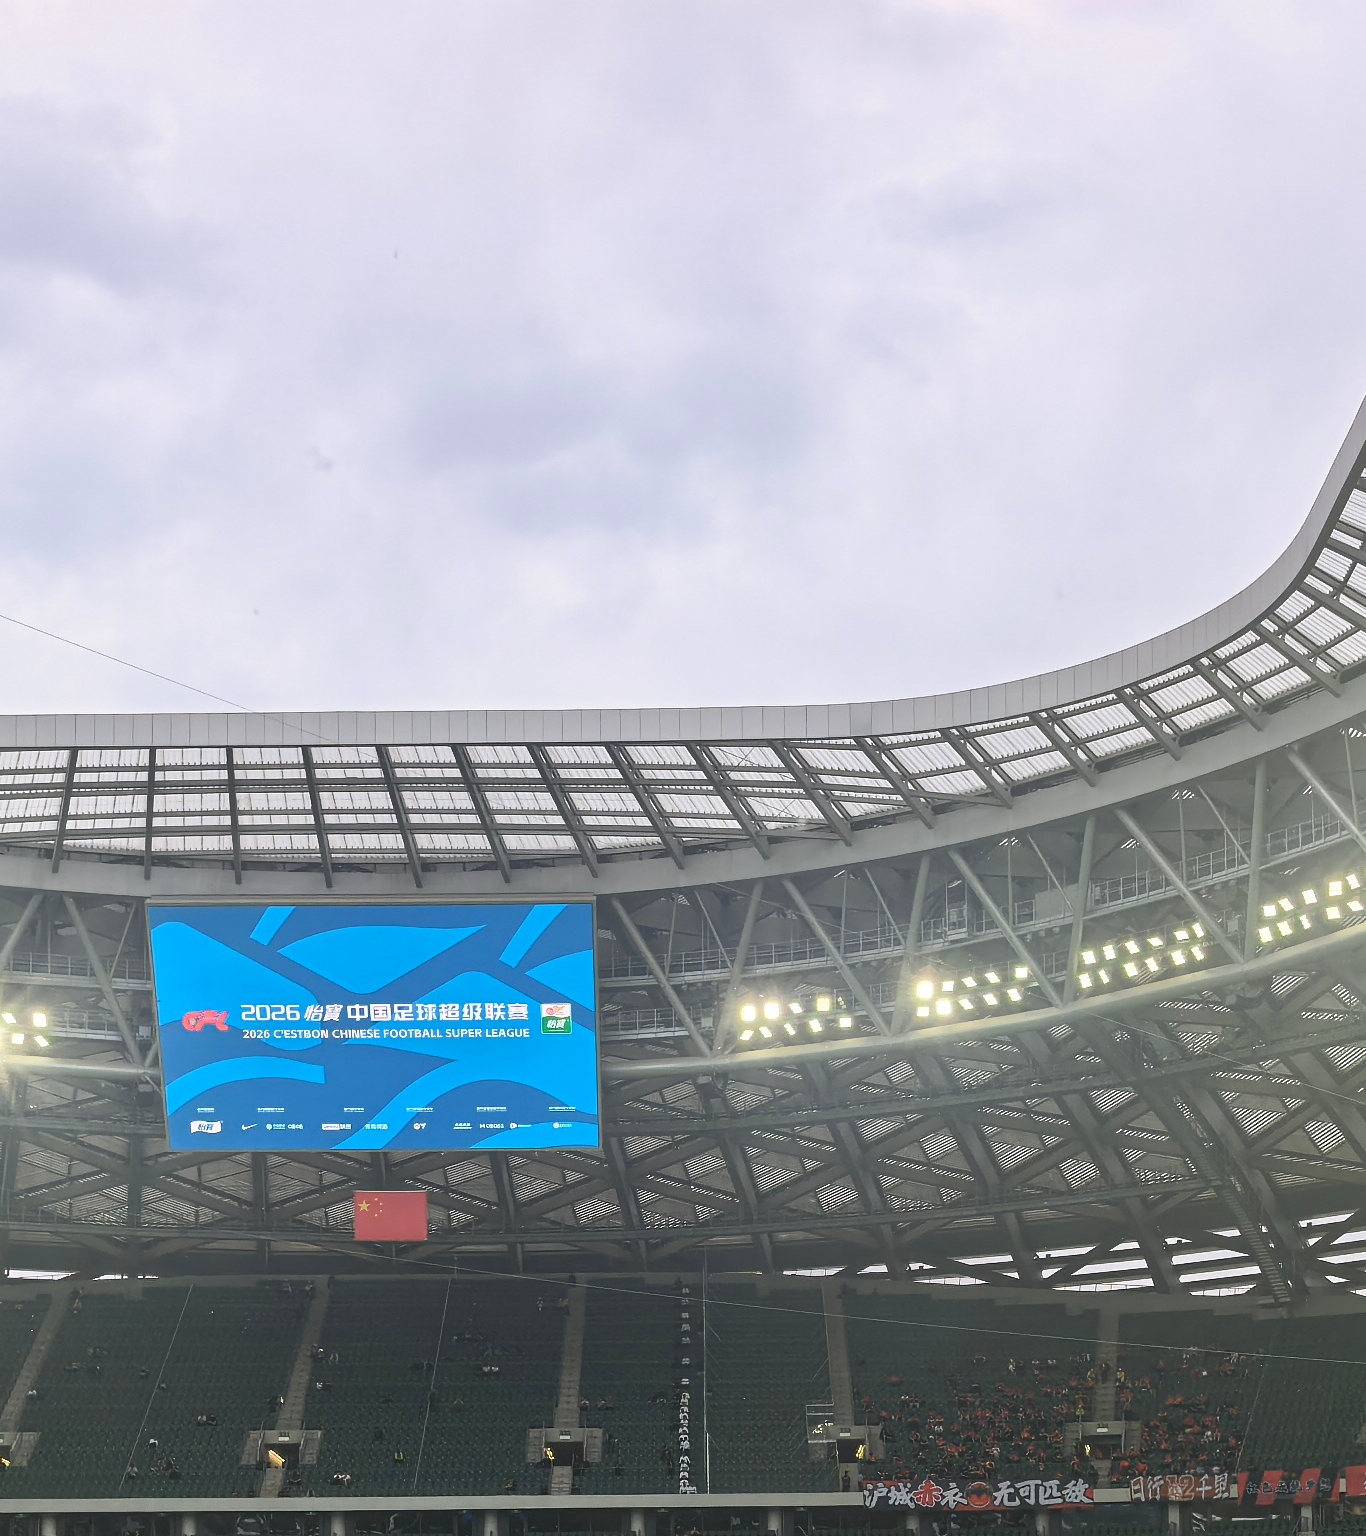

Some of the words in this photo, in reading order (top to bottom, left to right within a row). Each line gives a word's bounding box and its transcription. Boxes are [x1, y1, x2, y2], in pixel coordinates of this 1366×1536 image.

[241, 1003, 300, 1021] 2026
[304, 1003, 342, 1021] 怡寶
[347, 1002, 529, 1022] 中国足球超级联赛
[242, 1029, 270, 1040] 2026
[273, 1028, 329, 1040] C'ESTBON
[332, 1028, 380, 1039] CHINESE
[383, 1028, 442, 1039] FOOTBALL
[445, 1028, 480, 1039] SUPER
[483, 1027, 530, 1039] LEAGUE
[864, 1480, 968, 1509] 沪城赤衣
[993, 1478, 1095, 1507] 无可匹敌
